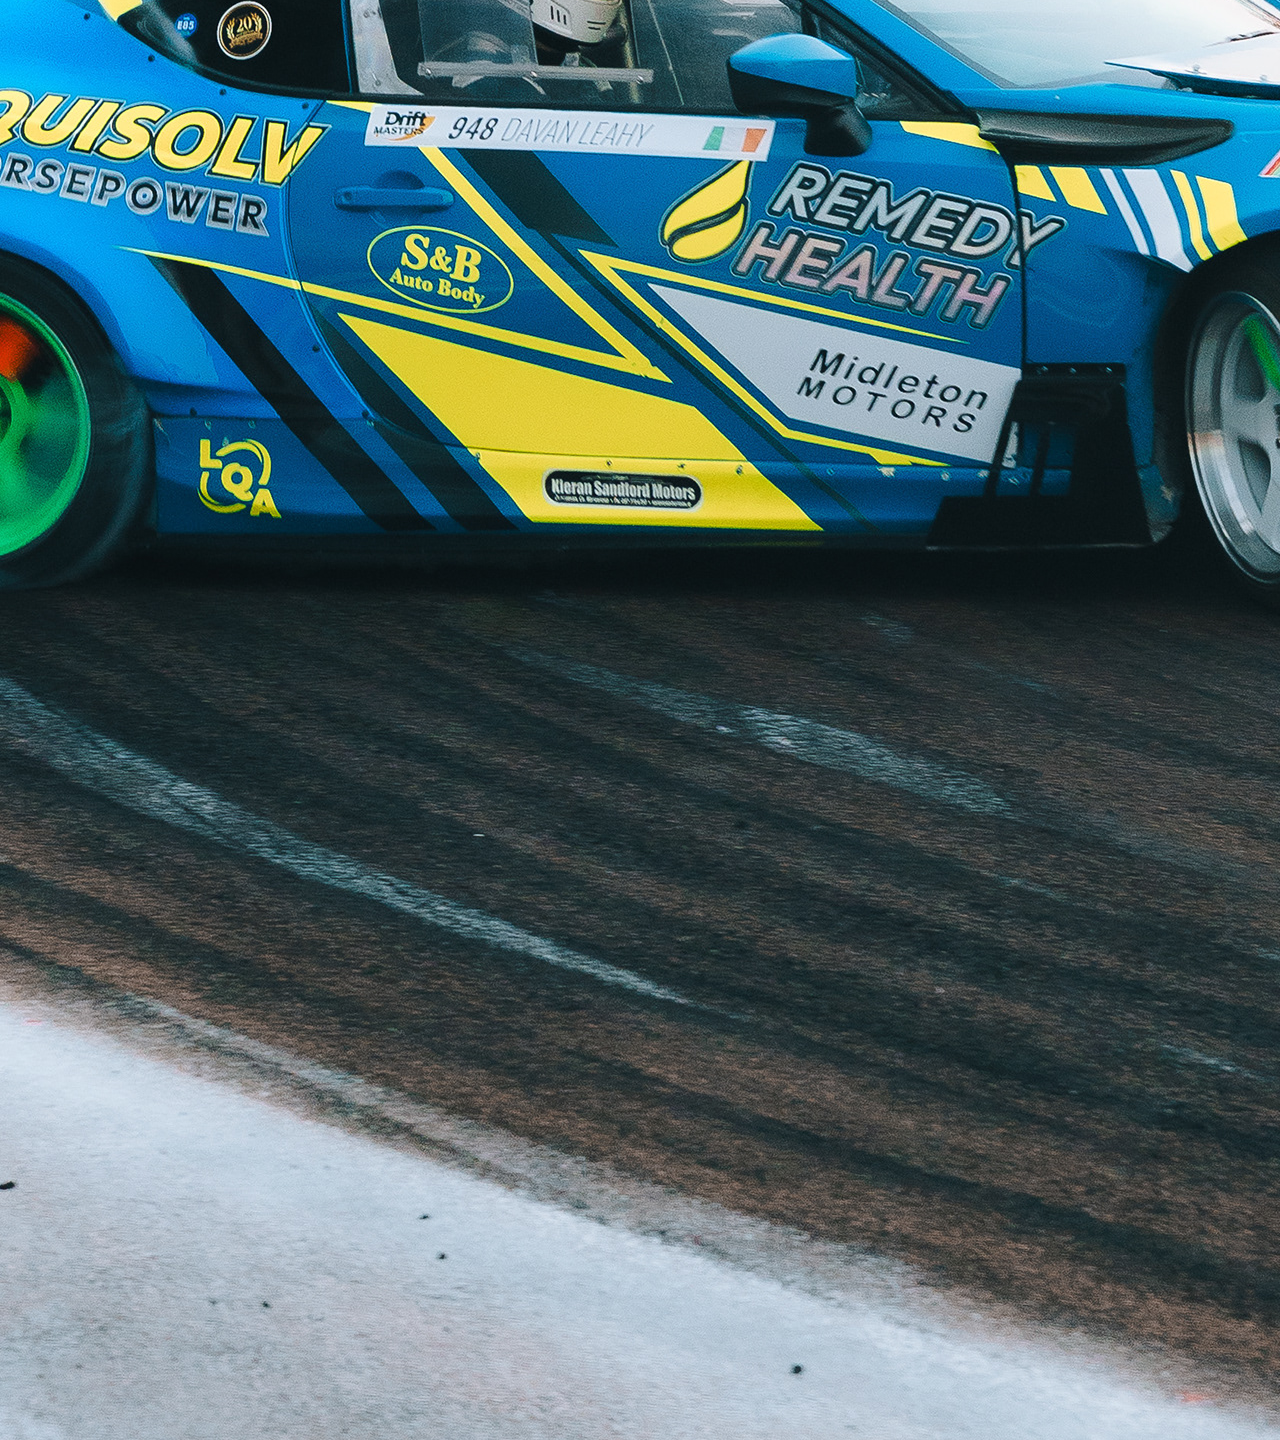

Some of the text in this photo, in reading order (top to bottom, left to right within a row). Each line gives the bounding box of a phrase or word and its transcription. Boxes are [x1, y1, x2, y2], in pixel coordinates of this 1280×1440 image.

[385, 111, 427, 127] Drift
[448, 117, 654, 147] 948 DAVAN LEAHY
[766, 160, 1067, 270] REMEDY
[401, 233, 482, 283] S&B
[730, 221, 1015, 330] HEALTH
[389, 267, 485, 309] Auto Body
[796, 376, 977, 433] MOTORS
[809, 349, 989, 410] Midleton
[651, 483, 696, 500] Motors
